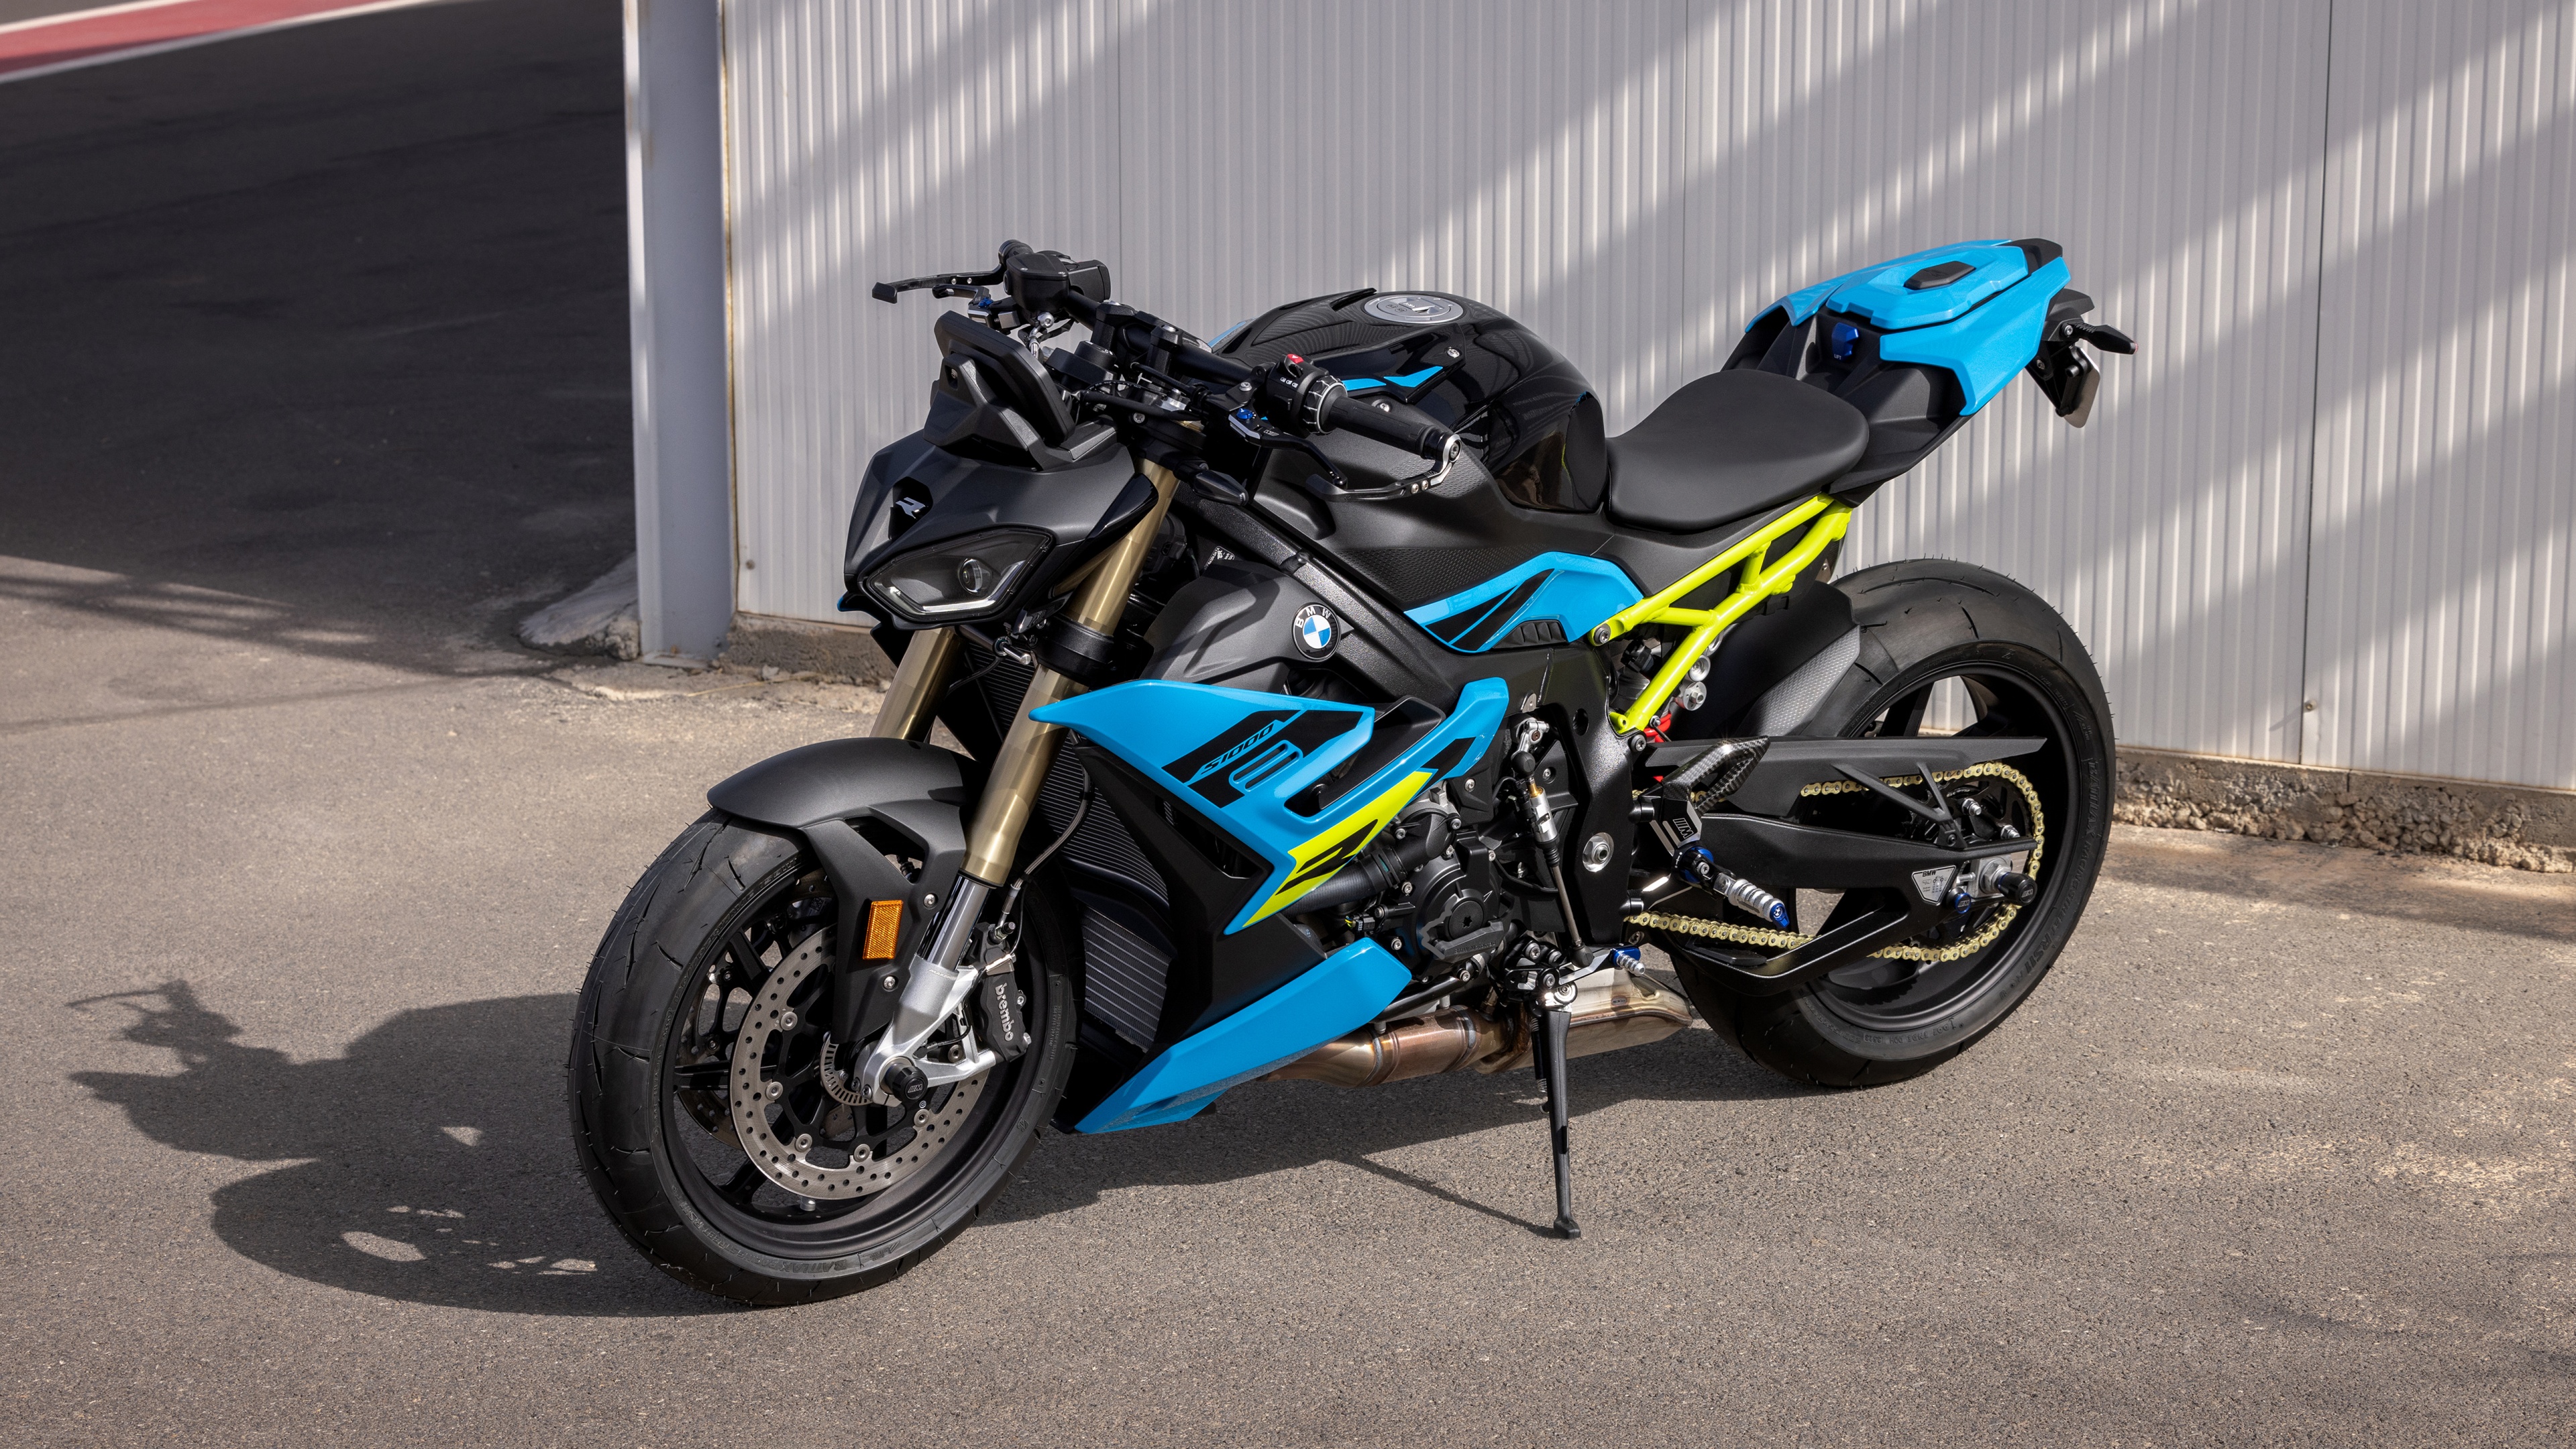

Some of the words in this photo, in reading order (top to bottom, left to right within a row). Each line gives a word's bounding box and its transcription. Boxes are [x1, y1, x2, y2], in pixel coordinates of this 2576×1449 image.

[1295, 606, 1332, 629] BMW
[1200, 723, 1274, 775] S1000
[1922, 869, 1937, 877] BMW
[995, 982, 1014, 1041] brembo
[779, 1258, 847, 1273] BATTLAX
